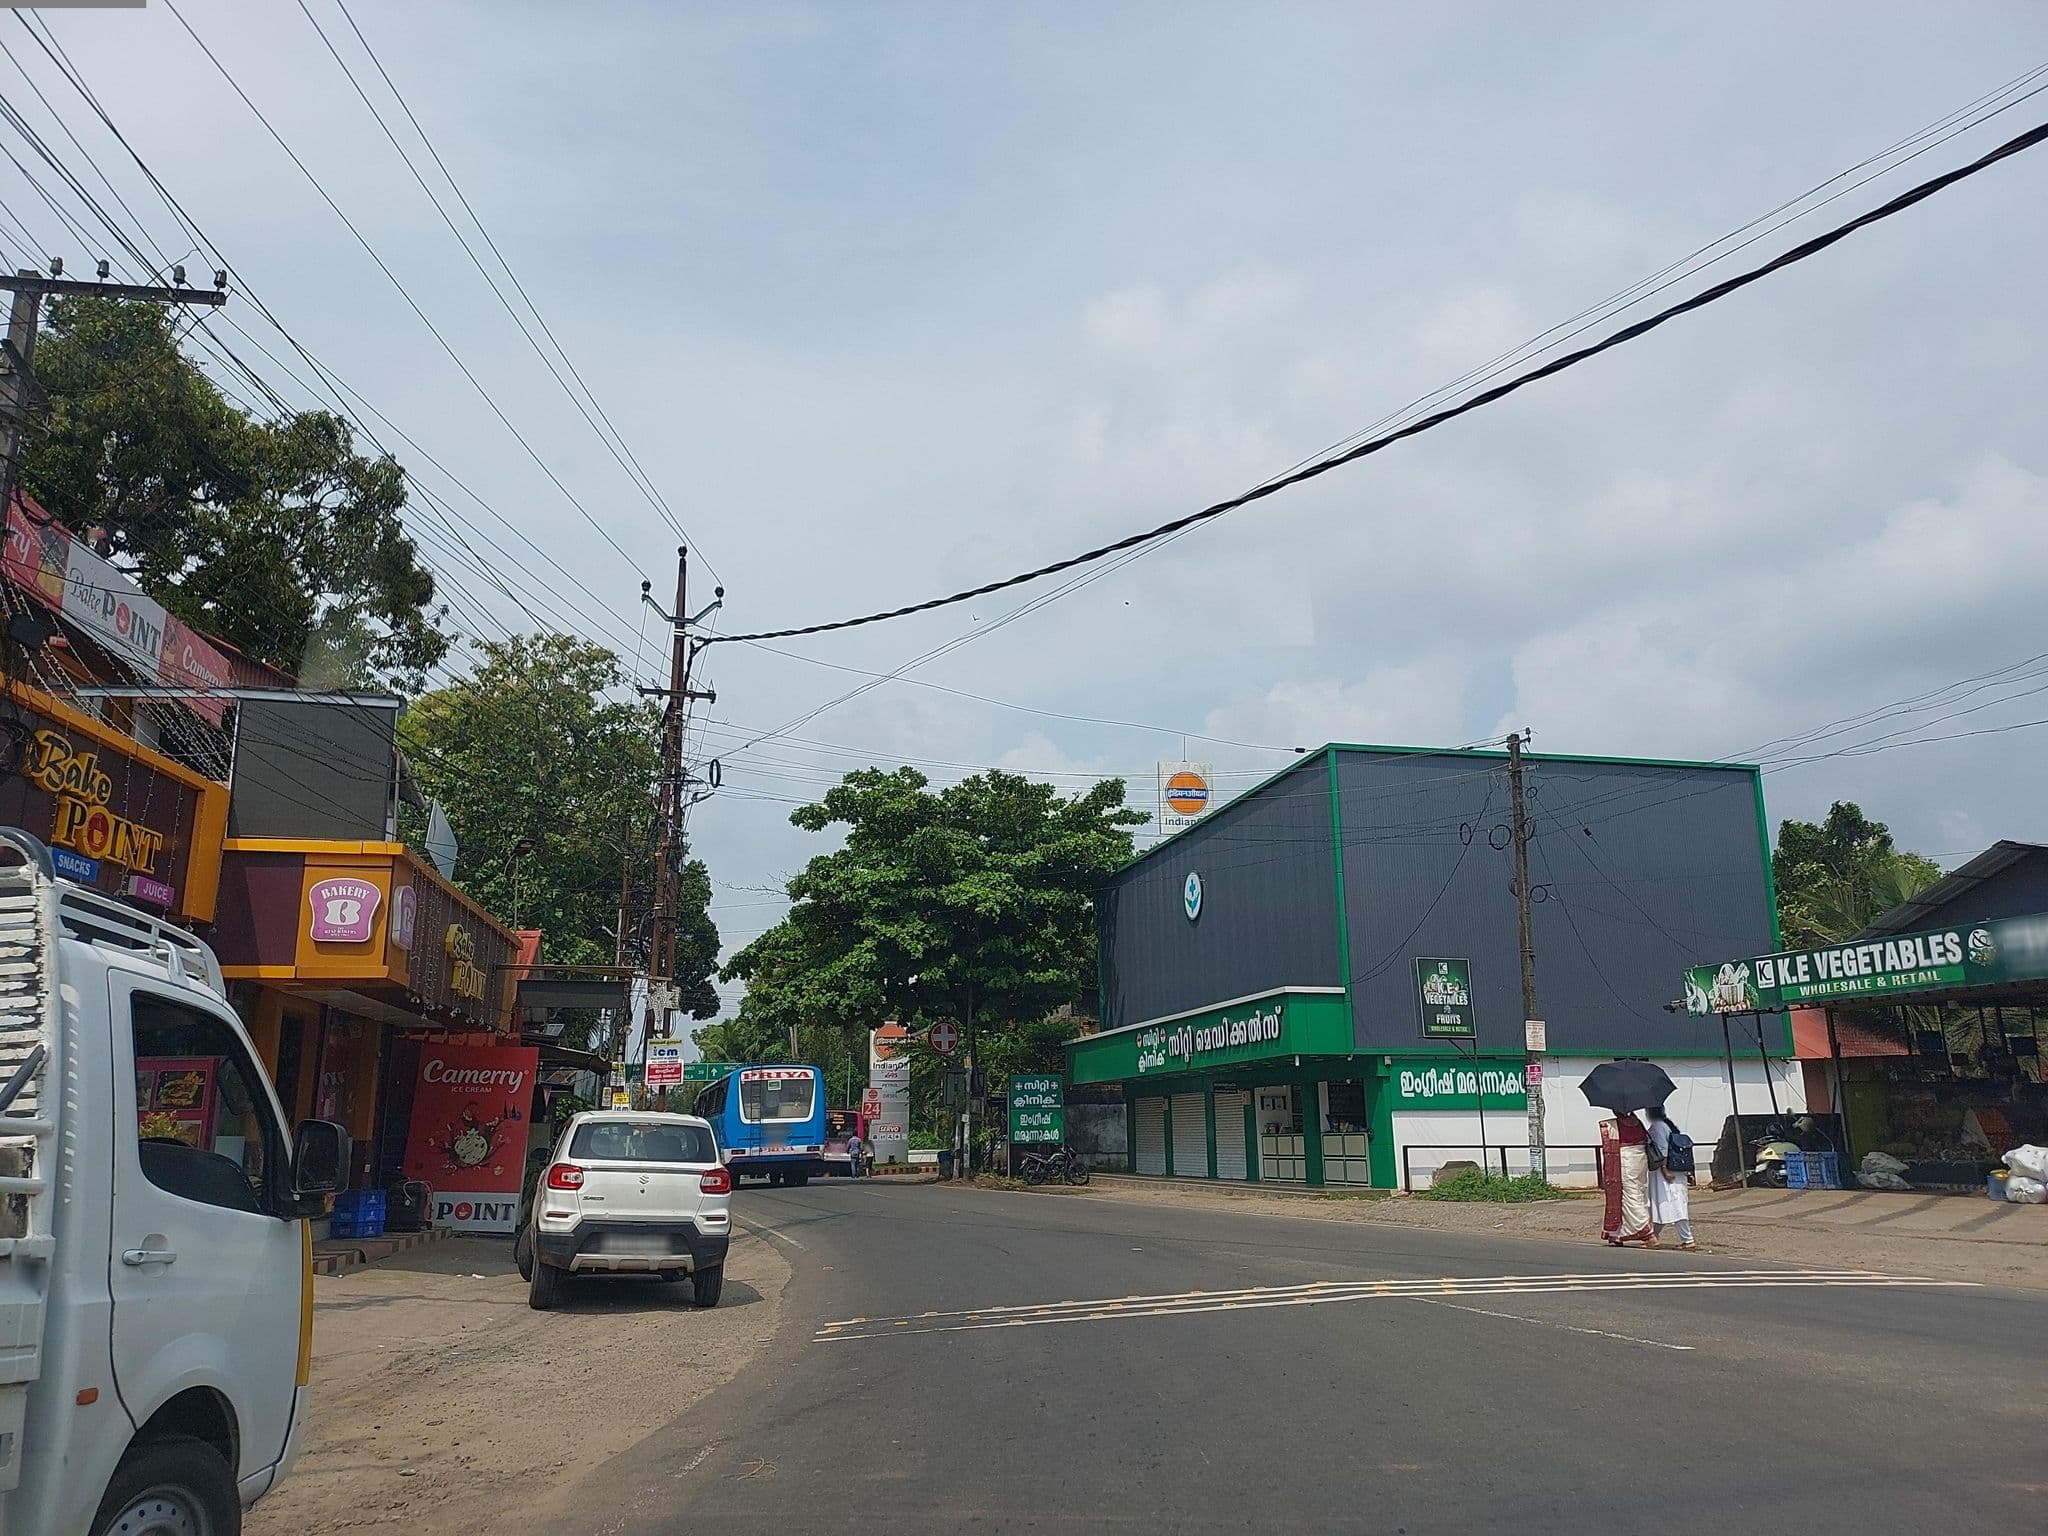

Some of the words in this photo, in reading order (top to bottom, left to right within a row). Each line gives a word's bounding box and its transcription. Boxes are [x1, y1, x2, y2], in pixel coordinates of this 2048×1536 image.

[69, 567, 101, 613] Bake
[103, 590, 162, 657] POINT
[182, 645, 224, 688] Camerr
[27, 730, 112, 805] Bake
[1165, 817, 1203, 826] Indian
[58, 797, 164, 874] POINT
[57, 854, 91, 876] SNACKS
[143, 882, 168, 899] JUICE
[321, 885, 370, 900] BAKERY
[1776, 955, 1810, 985] K.E
[1813, 931, 1963, 980] VEGETABLES
[1799, 978, 1872, 996] WHOLESALE
[1876, 976, 1887, 986] &
[1892, 970, 1941, 985] RETAIL
[1436, 1014, 1461, 1024] FRUITS
[1168, 1025, 1194, 1063] സിറ്റി
[1195, 1005, 1282, 1051] മെഡിക്കൽസ്
[423, 1059, 524, 1094] Camerry
[743, 1070, 811, 1080] PRIYA
[1024, 1080, 1049, 1092] സിറ്റി
[863, 1103, 881, 1115] 24
[436, 1202, 516, 1222] POINT
